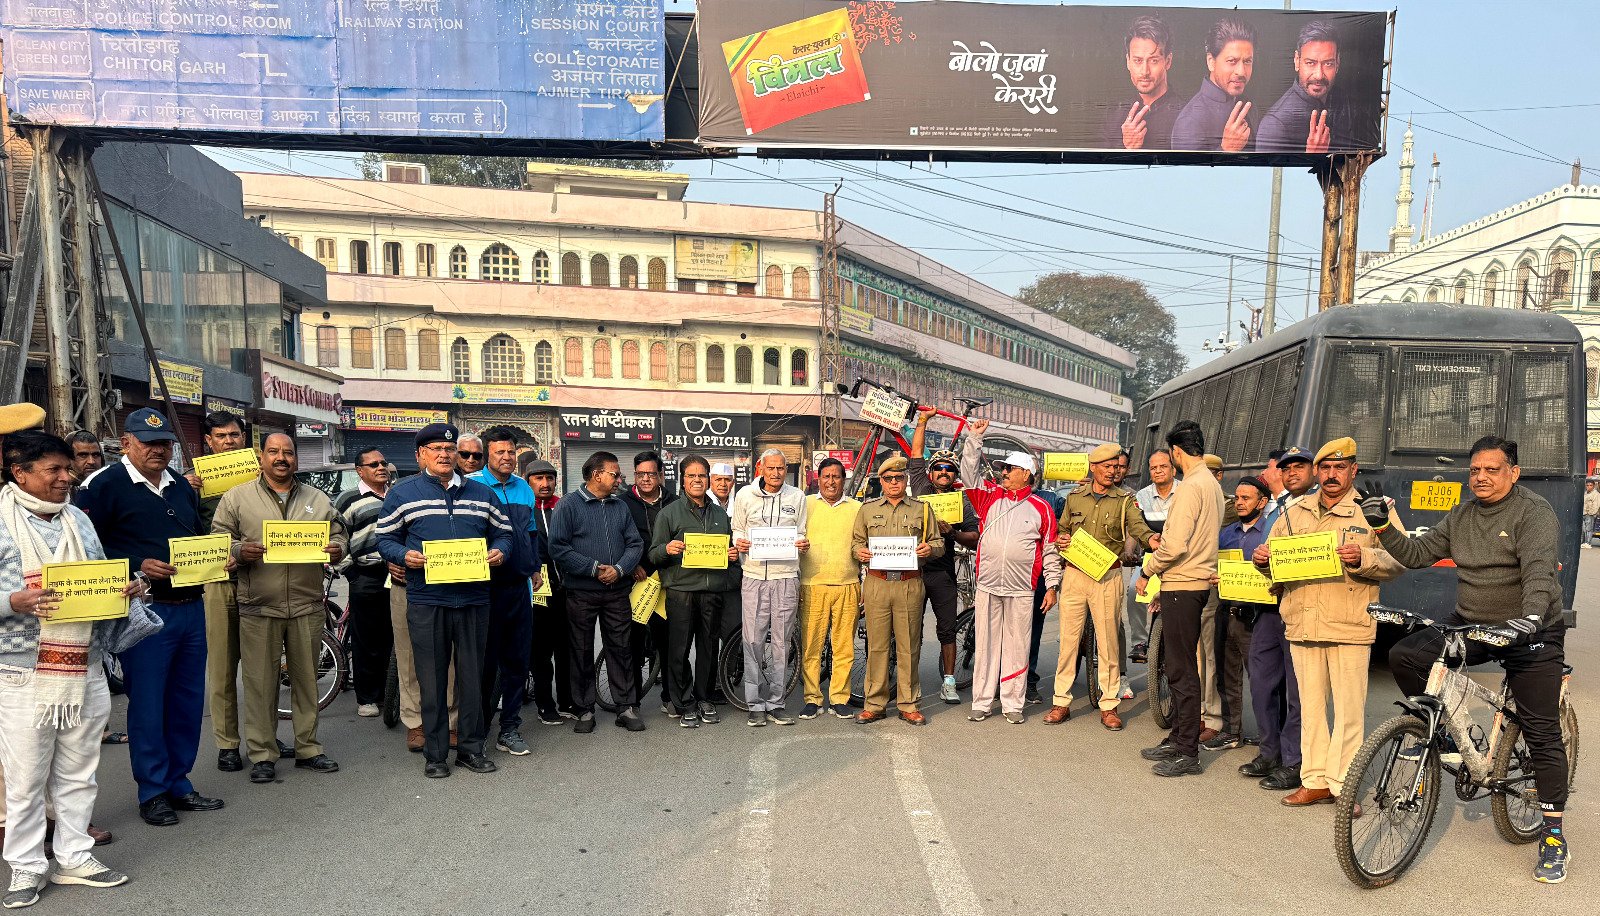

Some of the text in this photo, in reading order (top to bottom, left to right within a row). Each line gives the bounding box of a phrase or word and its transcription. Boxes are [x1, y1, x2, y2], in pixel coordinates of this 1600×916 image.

[95, 12, 291, 29] POLICE CONTROL ROOM
[344, 17, 463, 30] RAILWAY STATION
[531, 18, 659, 33] SESSION COURT
[16, 40, 86, 51] CLEAN CITY
[16, 54, 88, 65] GREEN CITY
[534, 52, 659, 69] COLLECTORATE
[948, 40, 1002, 72] बोलो
[103, 57, 226, 75] CHITTOR GARH
[551, 66, 658, 88] अजमेर तिराहा
[20, 89, 91, 100] SAVE WATER
[537, 86, 591, 99] AJMER
[992, 72, 1059, 115] केसरी
[28, 103, 85, 113] SAVE CITY
[272, 109, 319, 122] आपका
[326, 106, 370, 124] हार्दिक
[378, 111, 421, 124] स्वागत
[429, 112, 466, 124] करता
[473, 106, 484, 126] है
[561, 410, 656, 429] रतन ऑप्टीकल्स
[665, 435, 748, 447] RAJ OPTICAL
[1428, 485, 1452, 496] RJ06
